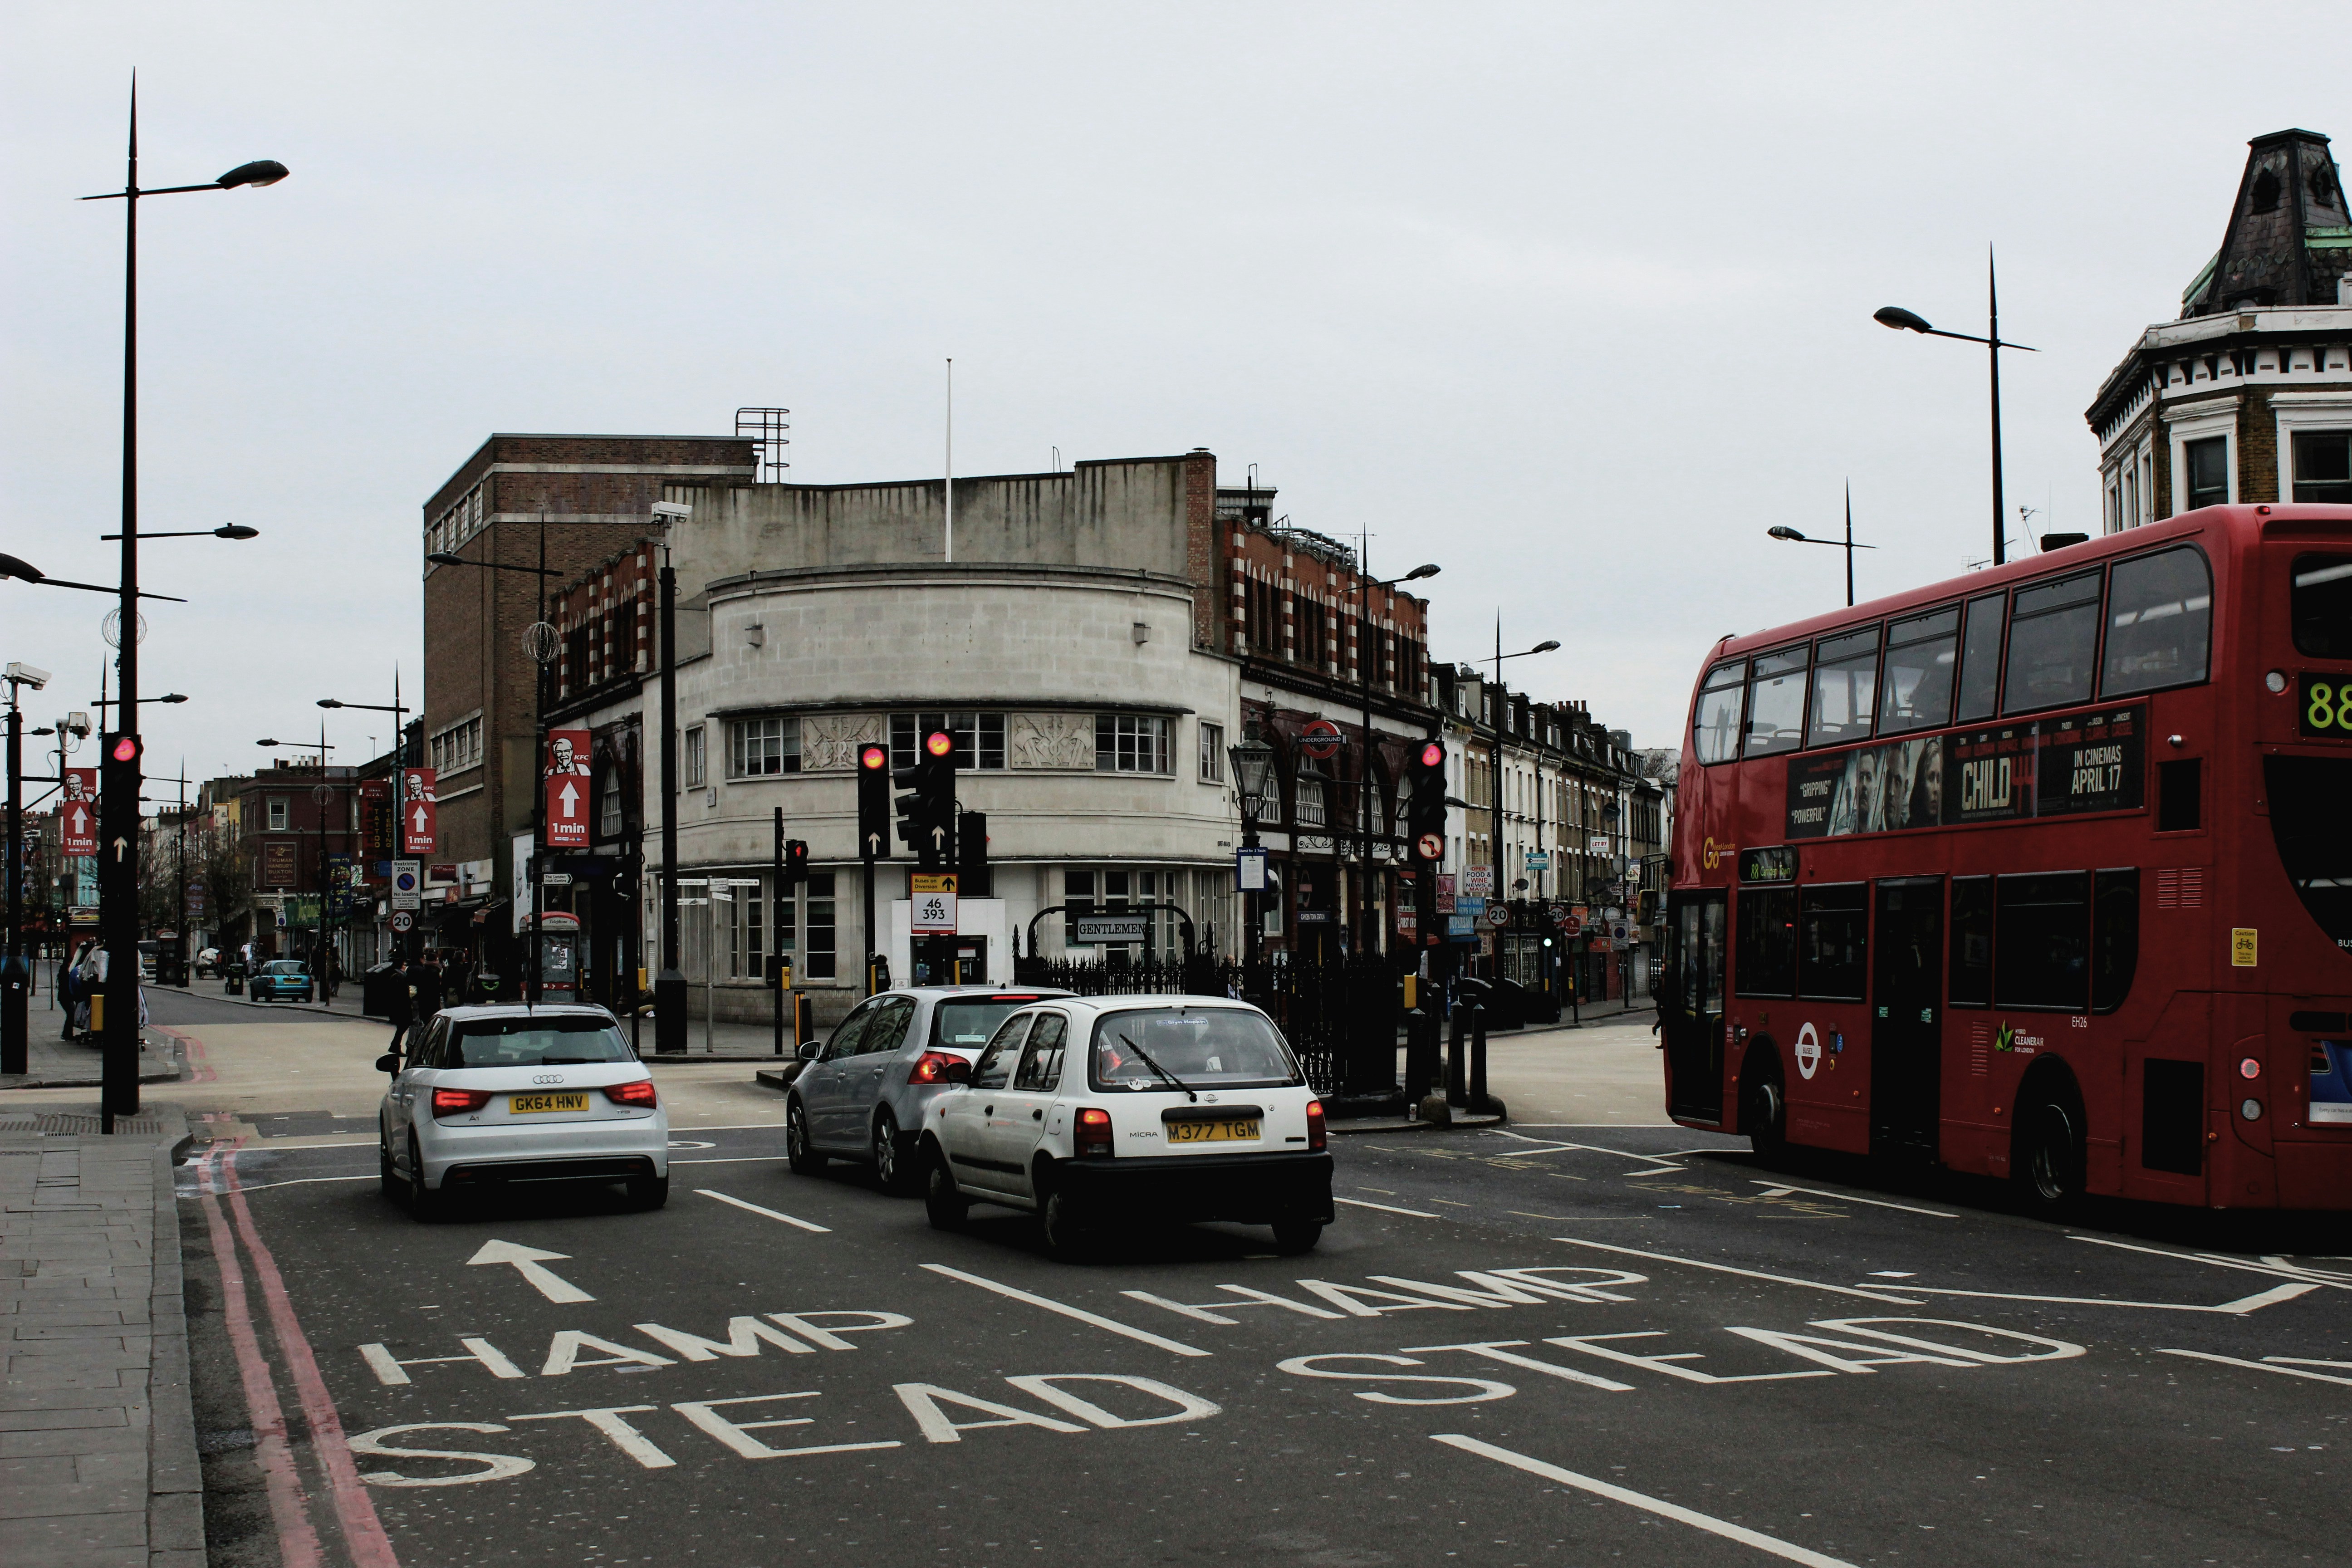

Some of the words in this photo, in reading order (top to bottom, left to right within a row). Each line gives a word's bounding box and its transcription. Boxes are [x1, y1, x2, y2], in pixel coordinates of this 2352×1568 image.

[2308, 682, 2352, 730] 88
[2074, 750, 2083, 768] IN
[2085, 745, 2122, 766] CINEMAS
[1961, 757, 2011, 811] CHILD
[2011, 754, 2035, 814] 44
[2071, 767, 2105, 794] APRIL
[2108, 764, 2122, 791] 17
[552, 823, 558, 833] 1
[560, 823, 585, 833] min
[67, 838, 72, 846] 1
[73, 838, 93, 846] min
[408, 836, 413, 844] 1
[414, 836, 433, 844] min
[1751, 863, 1759, 879] 88
[1760, 866, 1777, 877] Camden
[1779, 865, 1791, 875] Town
[926, 898, 942, 909] 46
[394, 916, 411, 926] 20
[923, 909, 945, 920] 393
[1491, 910, 1506, 920] 20
[1079, 923, 1147, 934] GENTLEMEN
[1401, 918, 1409, 928] FIRST
[2072, 1016, 2087, 1028] EH26
[516, 1096, 553, 1110] GK64
[556, 1095, 583, 1108] HNV
[1167, 1123, 1215, 1140] M377
[1222, 1121, 1259, 1138] TGM
[1120, 1266, 1650, 1324] HAMP
[356, 1309, 914, 1385] HAMP
[1275, 1317, 2087, 1406] STEAD
[346, 1372, 1222, 1488] STEAD
